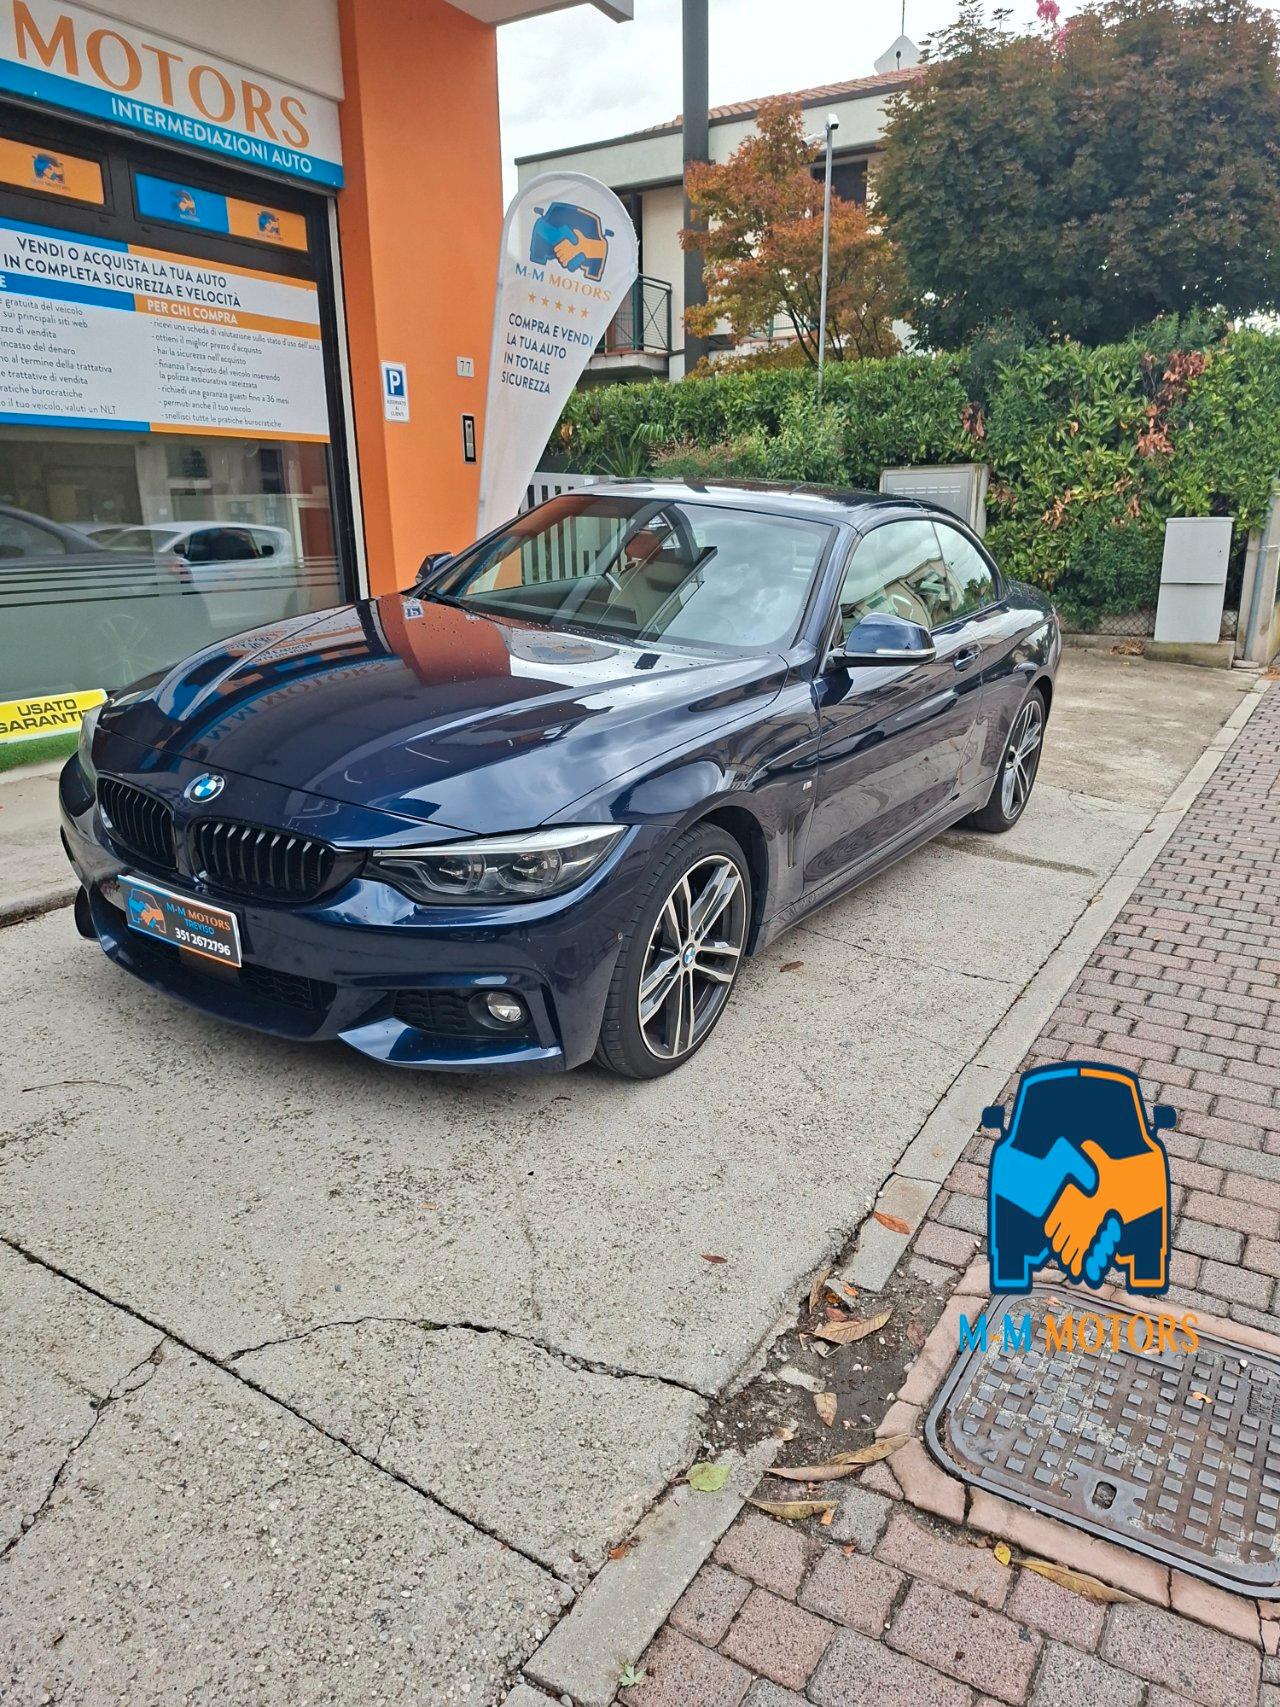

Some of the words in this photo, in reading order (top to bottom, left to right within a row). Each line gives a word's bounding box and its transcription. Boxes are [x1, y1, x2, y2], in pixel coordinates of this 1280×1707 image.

[13, 0, 310, 149] MOTORS
[112, 98, 268, 161] INTERMEDIAZIONI
[272, 150, 312, 174] AUTO
[16, 236, 64, 258] VENDI
[68, 248, 79, 260] O
[83, 251, 149, 274] ACQUISTA
[152, 264, 167, 278] LA
[170, 267, 194, 282] TUA
[196, 273, 227, 288] AUTO
[4, 254, 21, 269] IN
[25, 259, 101, 283] COMPLETA
[104, 272, 174, 296] SICUREZZA
[176, 286, 183, 298] E
[185, 287, 241, 308] VELOCITÀ
[515, 263, 545, 283] M-M
[549, 274, 612, 302] MOTORS
[5, 298, 39, 309] gratuita
[41, 301, 53, 311] del
[56, 304, 83, 315] veicolo
[147, 300, 169, 314] PER
[170, 304, 191, 317] CHI
[192, 307, 238, 325] COMPRA
[18, 311, 57, 326] principali
[73, 320, 88, 328] web
[154, 319, 171, 329] ricevi
[16, 325, 24, 335] di
[27, 329, 57, 339] vendita
[509, 313, 550, 336] COMPRA
[553, 326, 559, 338] E
[561, 327, 594, 347] VENDI
[34, 342, 46, 351] del
[48, 344, 76, 355] denaro
[156, 334, 179, 343] ottieni
[186, 339, 208, 349] miglior
[210, 342, 230, 351] prezzo
[507, 332, 517, 347] LA
[520, 336, 538, 353] TUA
[540, 344, 567, 359] AUTO
[157, 346, 168, 355] hai
[177, 349, 206, 359] sicurezza
[12, 354, 19, 364] al
[21, 357, 54, 367] termine
[56, 359, 74, 370] della
[77, 363, 113, 373] trattativa
[159, 359, 185, 371] finanzia
[230, 369, 251, 378] veicolo
[460, 360, 471, 373] 77
[504, 352, 514, 365] IN
[516, 355, 550, 375] TOTALE
[8, 371, 47, 381] trattative
[50, 372, 57, 381] di
[60, 375, 88, 385] vendita
[168, 373, 190, 383] polizza
[389, 371, 401, 394] P
[502, 371, 551, 394] SICUREZZA
[32, 386, 83, 398] burocratiche
[162, 385, 187, 394] richiedi
[267, 395, 275, 403] 36
[65, 403, 86, 413] valuti
[100, 405, 116, 415] NLT
[192, 402, 211, 410] anche
[17, 699, 77, 716] USATO
[166, 902, 186, 917] M-M
[187, 910, 231, 931] MOTORS
[184, 918, 215, 935] TREVISO
[175, 928, 190, 942] 351
[191, 934, 231, 956] 2672796
